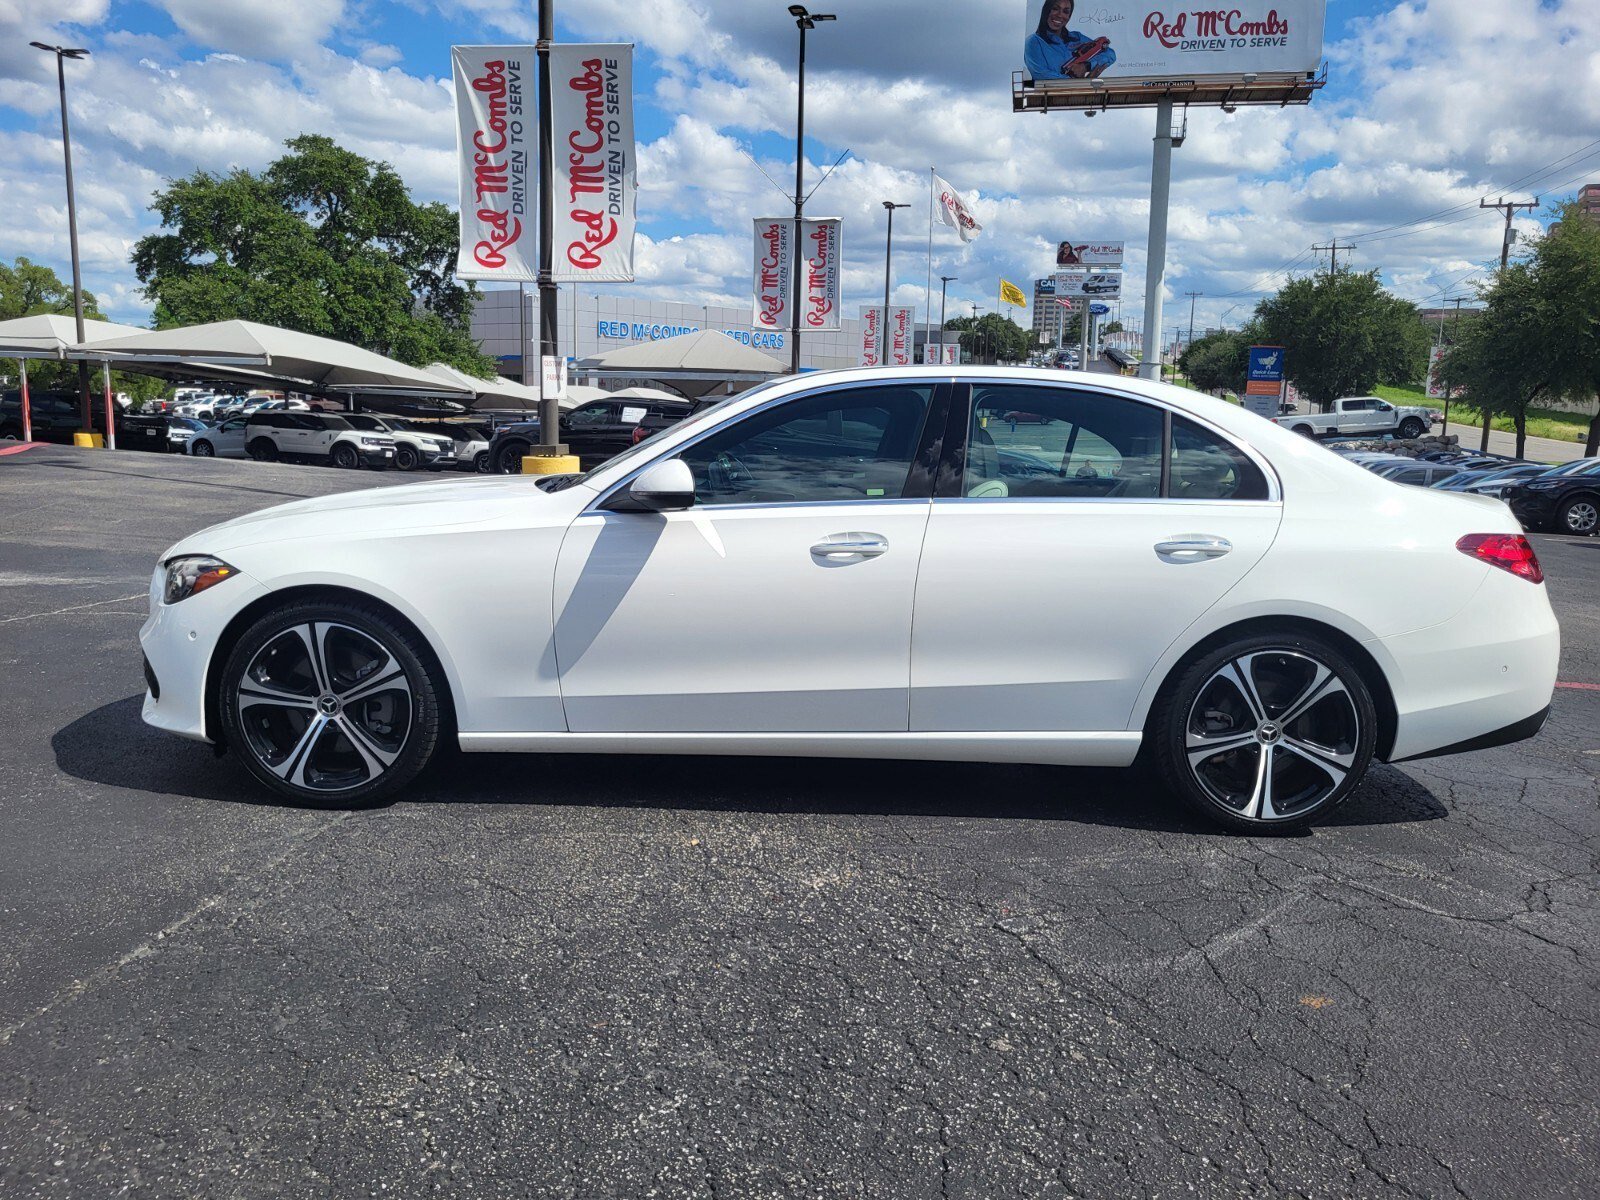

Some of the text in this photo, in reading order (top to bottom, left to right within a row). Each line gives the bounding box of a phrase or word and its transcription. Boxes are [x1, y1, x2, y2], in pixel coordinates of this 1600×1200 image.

[1143, 11, 1187, 48] Red
[1191, 9, 1288, 37] McCombs
[1181, 37, 1288, 50] DRIVEN TO SERVE
[472, 60, 522, 268] Red McCombs
[508, 60, 523, 215] DRIVEN TO SERVE
[567, 58, 618, 269] Red McCombs
[605, 58, 620, 215] DRIVEN TO SERVE
[760, 224, 784, 325] Red McCombs
[780, 253, 787, 264] TO
[807, 224, 833, 326] Red McCombs
[828, 253, 835, 264] TO
[598, 321, 629, 340] RED
[753, 333, 784, 348] CARS
[893, 353, 908, 365] ed
